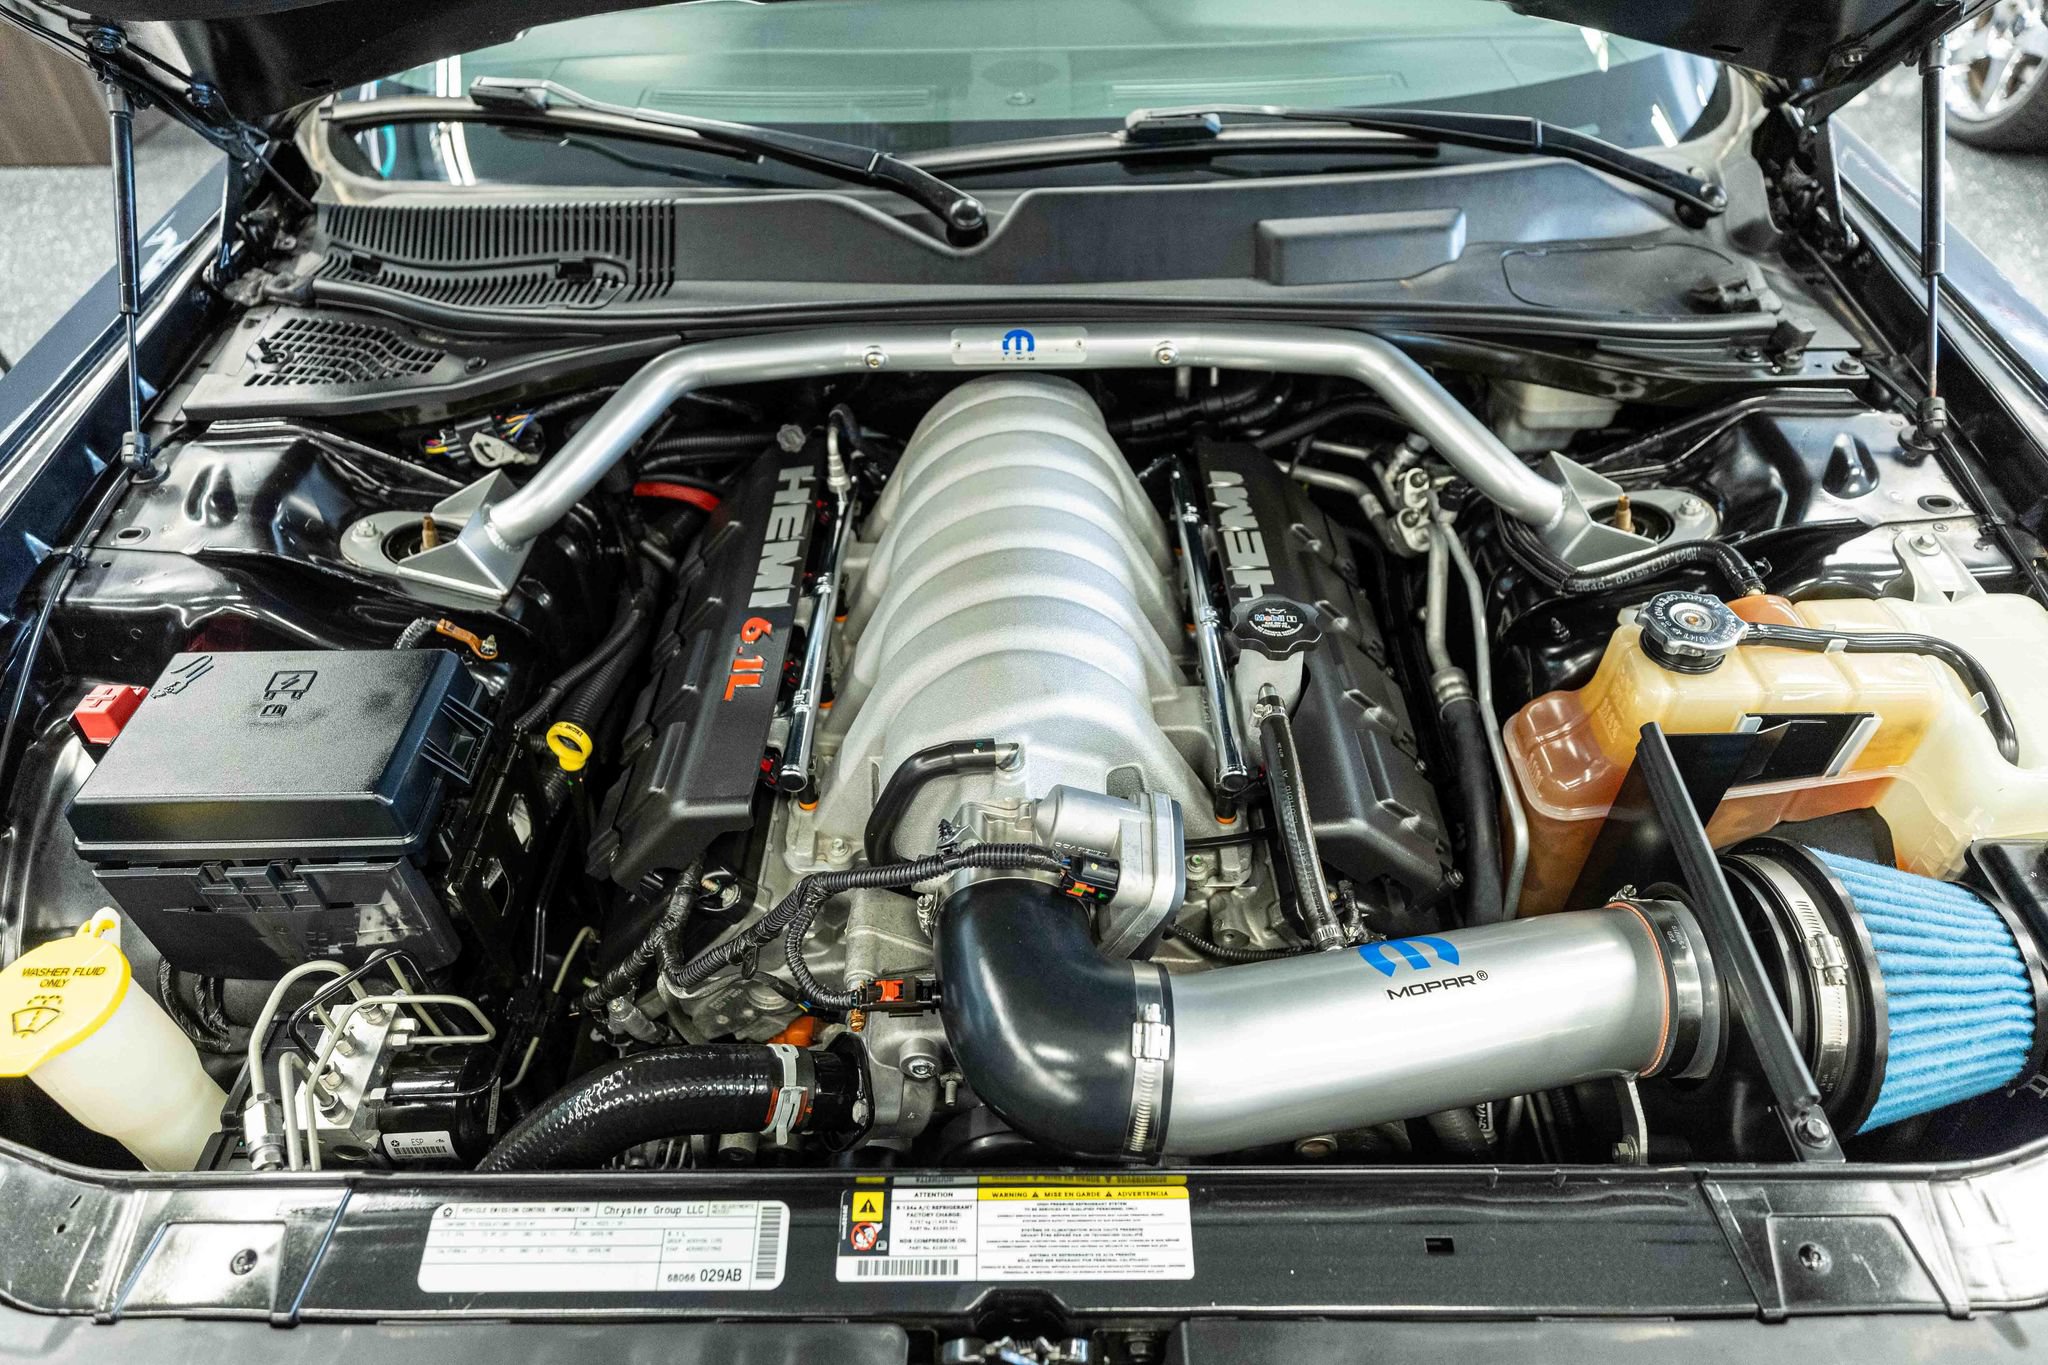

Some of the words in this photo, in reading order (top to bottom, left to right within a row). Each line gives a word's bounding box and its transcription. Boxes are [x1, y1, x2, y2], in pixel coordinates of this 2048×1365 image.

[748, 466, 816, 608] HEMI
[1254, 614, 1285, 622] Mobil
[723, 616, 773, 701] 6.1L
[22, 967, 70, 977] WASHER
[72, 966, 107, 977] FLUID
[39, 978, 70, 989] ONLY
[411, 1138, 424, 1146] ESP
[604, 1205, 647, 1217] Chrysler
[654, 1205, 682, 1217] Group
[686, 1205, 705, 1215] LLC
[700, 1268, 742, 1282] 029AB
